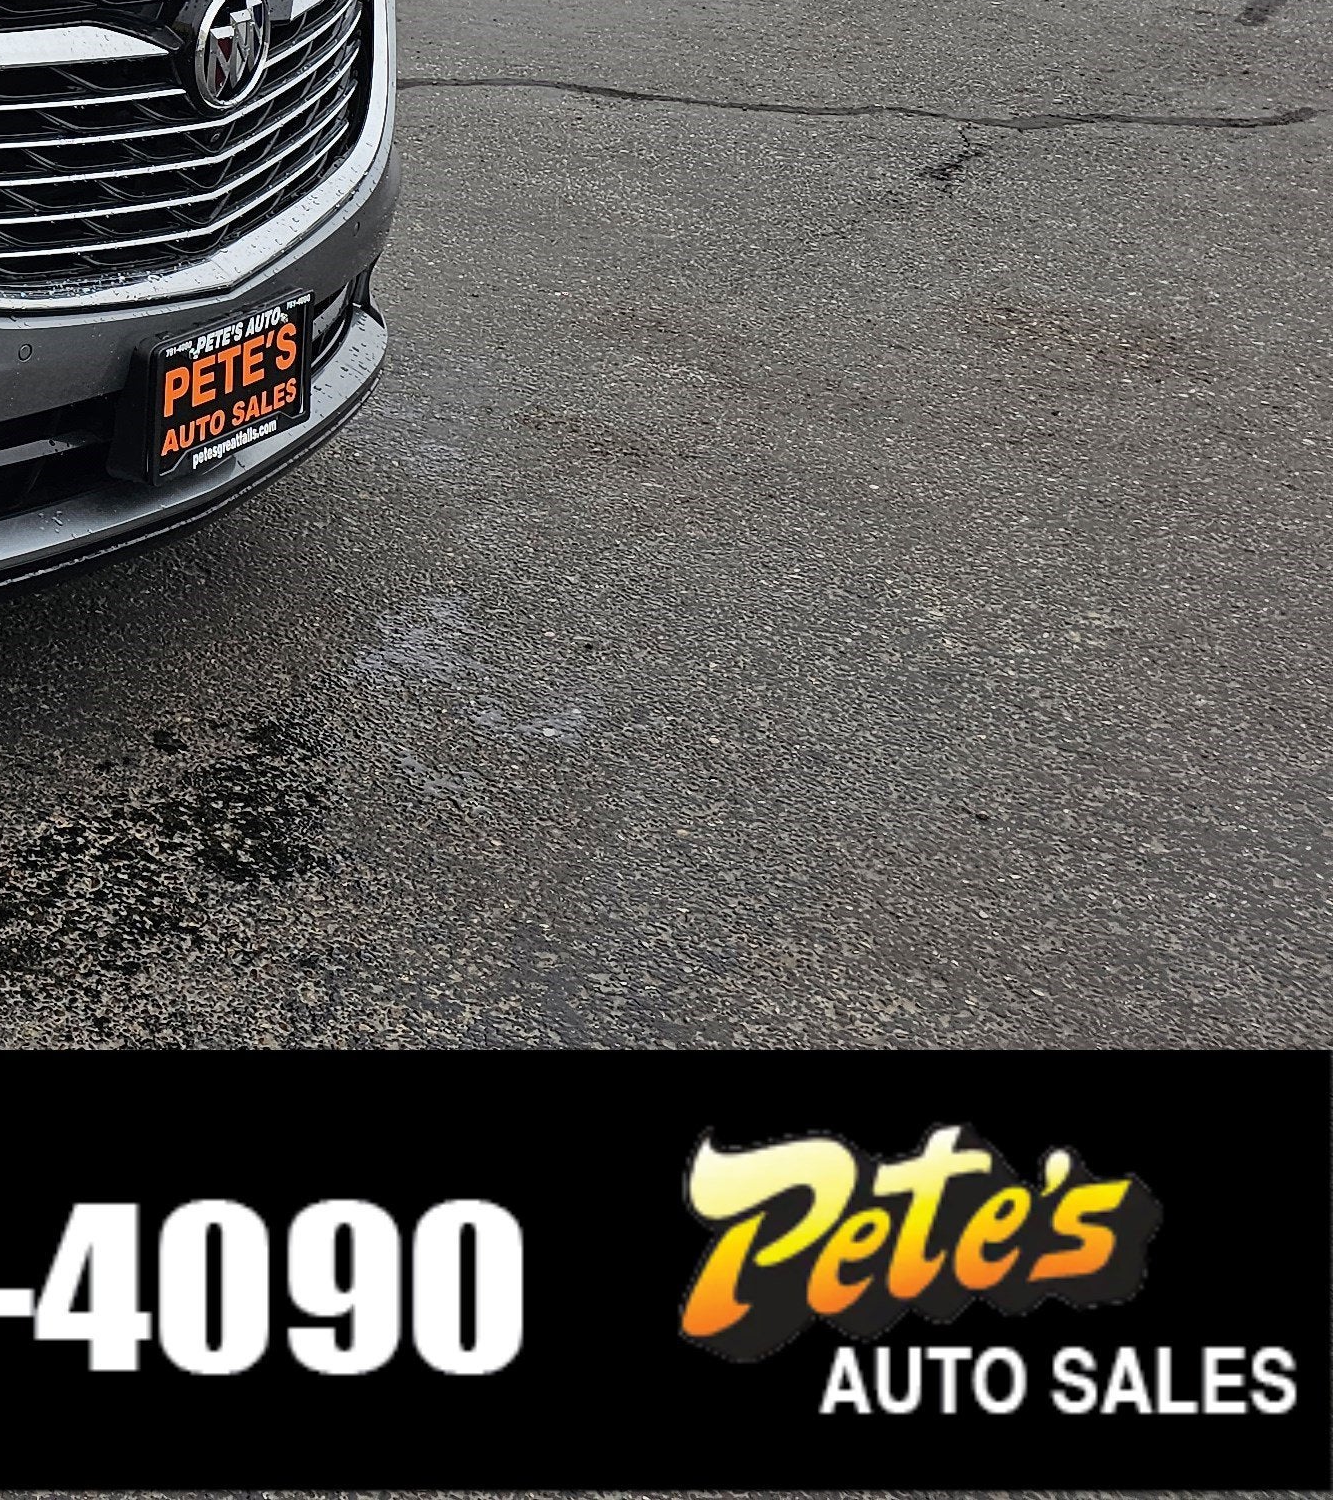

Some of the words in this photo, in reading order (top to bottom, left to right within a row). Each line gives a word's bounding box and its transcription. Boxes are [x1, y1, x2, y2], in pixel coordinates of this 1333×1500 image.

[197, 321, 244, 353] PETE'S
[245, 307, 281, 337] AUTO
[163, 322, 297, 417] PETE'S
[161, 410, 226, 457] AUTO
[232, 378, 296, 426] SALES
[192, 419, 277, 469] petesgreatfalls.com
